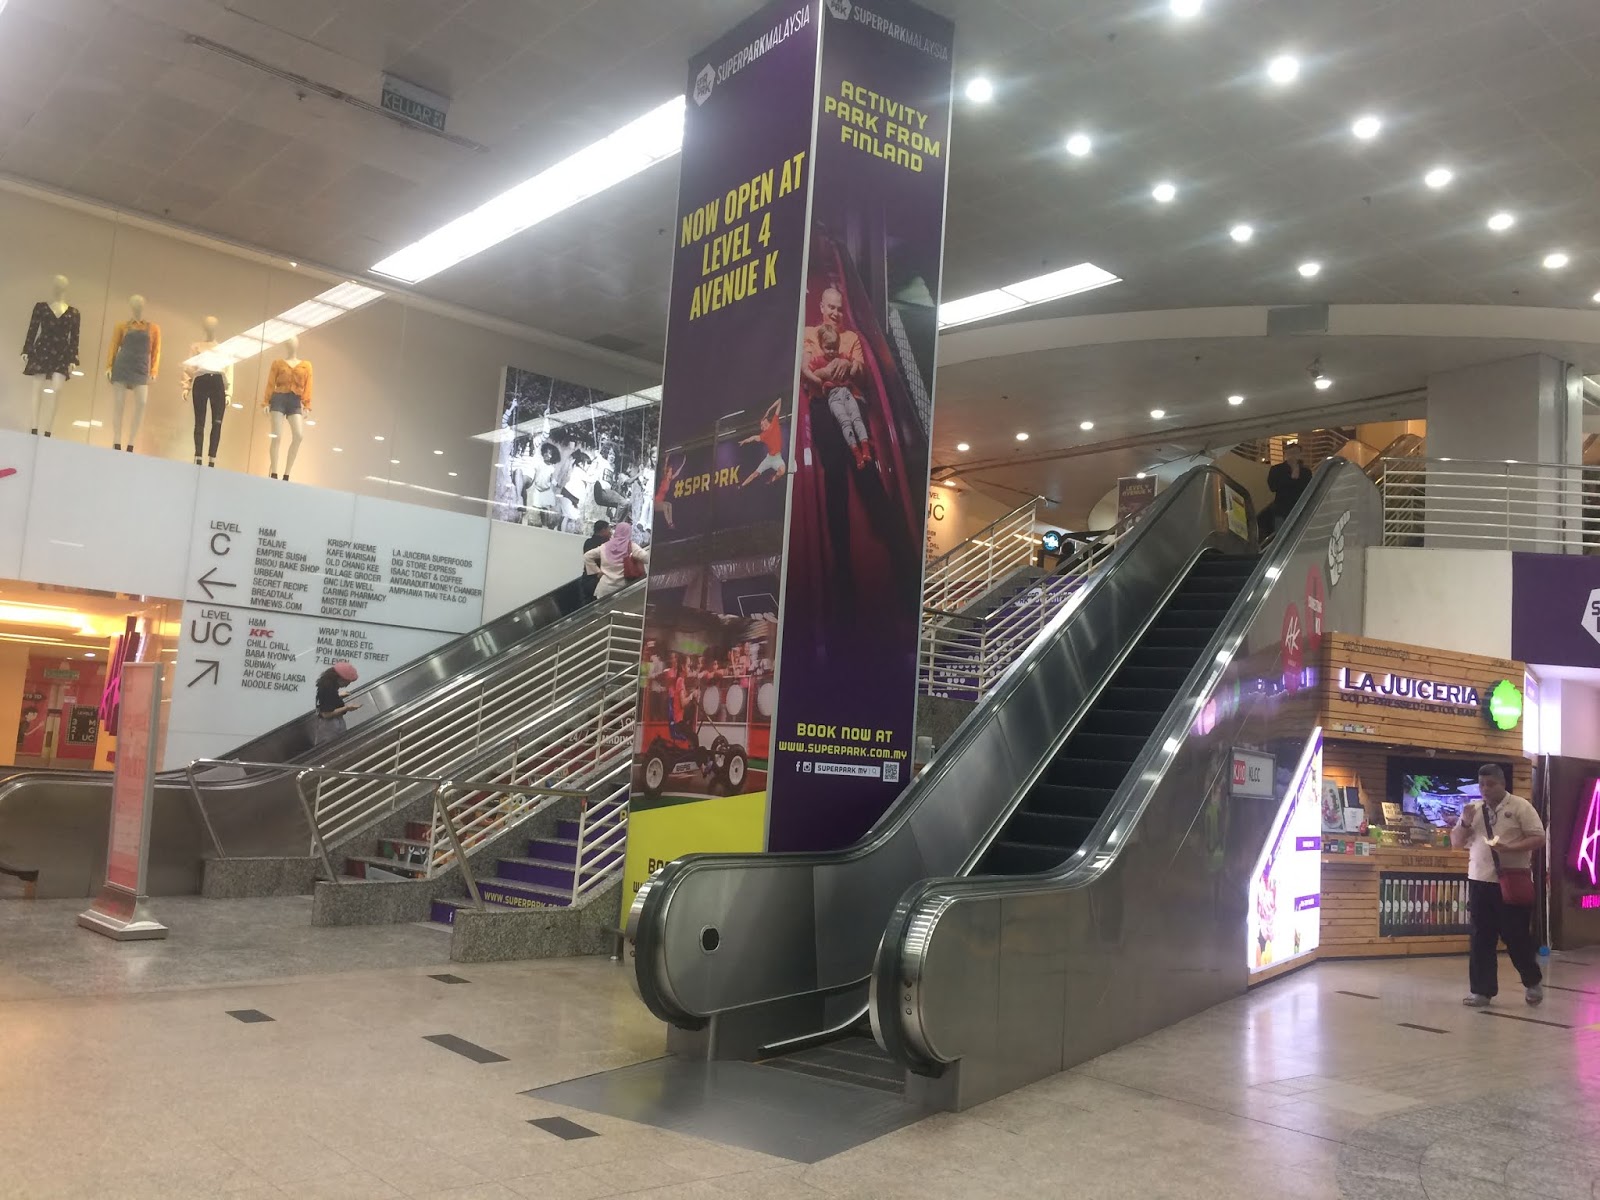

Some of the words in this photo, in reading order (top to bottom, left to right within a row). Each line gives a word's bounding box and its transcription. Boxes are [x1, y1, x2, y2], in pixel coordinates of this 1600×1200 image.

[841, 80, 928, 130] ACTIVITY
[825, 96, 879, 133] PARK
[885, 121, 940, 158] FROM
[841, 125, 923, 173] FINLAND
[681, 197, 720, 248] NOW
[724, 169, 774, 226] OPEN
[779, 151, 805, 198] AT
[702, 222, 751, 277] LEVEL
[758, 212, 771, 247] 4
[689, 259, 759, 321] AVENUE
[764, 250, 779, 290] K
[210, 520, 241, 533] LEVEL
[258, 527, 276, 537] H&M
[210, 532, 231, 556] C
[258, 537, 287, 549] TEALIVE
[327, 538, 352, 549] KRISPY
[353, 543, 376, 553] KREME
[256, 548, 283, 558] EMPIRE
[285, 551, 307, 562] SUSHI
[326, 548, 344, 558] KAFE
[345, 551, 376, 562] WARISAN
[392, 549, 401, 557] LA
[402, 551, 431, 561] JUICERIA
[432, 554, 473, 568] SUPERFOODS
[255, 557, 278, 568] BISOU
[278, 560, 298, 571] BAKE
[300, 564, 320, 573] SHOP
[325, 557, 340, 566] OLD
[341, 560, 365, 570] CHANG
[366, 564, 379, 572] KEE
[406, 560, 427, 570] STORE
[428, 564, 456, 575] EXPRESS
[253, 567, 283, 578] URBEAN
[325, 567, 352, 578] VILLAGE
[354, 571, 382, 582] GROCER
[390, 567, 410, 577] ISAAC
[411, 570, 432, 580] TOAST
[439, 575, 463, 585] COFFEE
[252, 577, 281, 588] SECRET
[283, 581, 309, 592] RECIPE
[323, 577, 338, 586] GNC
[340, 580, 354, 588] LIVE
[355, 581, 374, 591] WELL
[429, 581, 452, 592] MONEY
[453, 585, 482, 597] CHANGER
[251, 587, 294, 600] BREADTALK
[322, 586, 349, 597] CARING
[350, 590, 387, 602] PHARMACY
[388, 586, 423, 598] AMPHAWA
[424, 590, 438, 599] THAI
[321, 596, 347, 606] MISTER
[349, 600, 368, 609] MINIT
[201, 609, 232, 621] LEVEL
[320, 606, 342, 615] QUICK
[343, 609, 357, 617] CUT
[248, 618, 267, 627] H&M
[191, 620, 233, 646] UC
[249, 628, 275, 638] KFC
[318, 627, 339, 636] WRAP
[349, 630, 367, 639] ROLL
[246, 639, 267, 649] CHILL
[269, 641, 290, 651] CHILL
[317, 636, 334, 646] MAIL
[335, 639, 359, 649] BOXES
[245, 649, 265, 659] BABA
[267, 651, 296, 662] NYONYA
[315, 646, 333, 656] IPOH
[334, 649, 362, 659] MARKET
[363, 651, 390, 662] STREET
[244, 659, 276, 671] SUBWAY
[243, 669, 254, 678] AH
[255, 670, 281, 681] CHENG
[283, 673, 306, 683] LAKSA
[241, 679, 272, 690] NOODLE
[273, 681, 298, 692] SHACK
[1344, 667, 1376, 693] LA
[1380, 673, 1480, 706] JUICERIA
[797, 722, 837, 739] BOOK
[841, 726, 871, 742] NOW
[875, 729, 893, 743] AT
[778, 740, 907, 760] WWW.SUPERPARK.COM.MY
